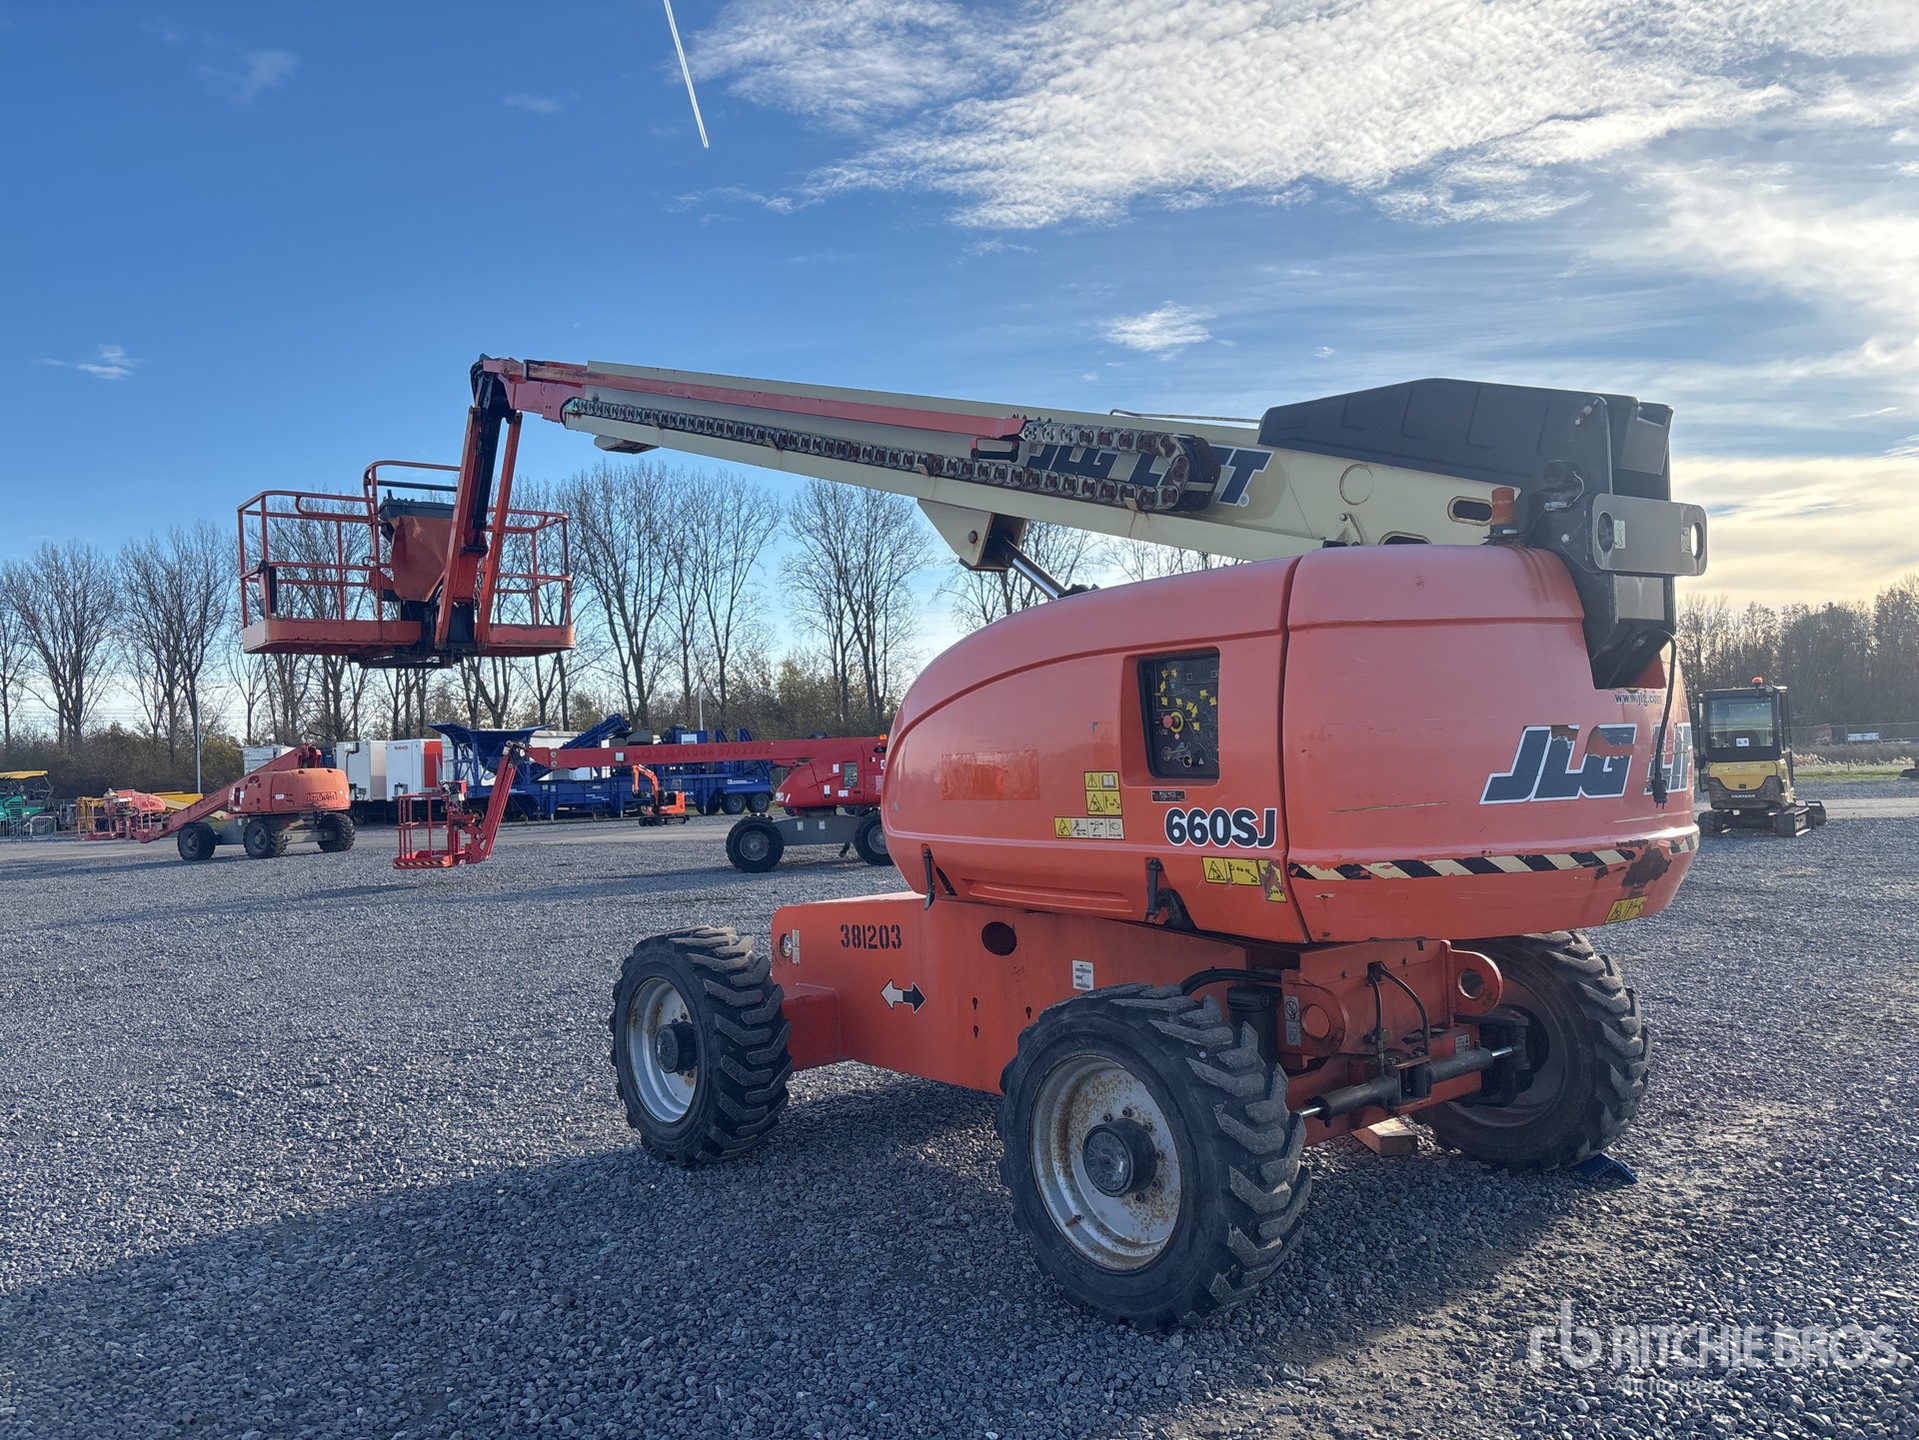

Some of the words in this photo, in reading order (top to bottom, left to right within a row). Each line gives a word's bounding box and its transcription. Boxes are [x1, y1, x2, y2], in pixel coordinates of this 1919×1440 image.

[1479, 723, 1638, 805] JLG
[1164, 807, 1278, 849] 660SJ
[840, 923, 902, 949] 381203
